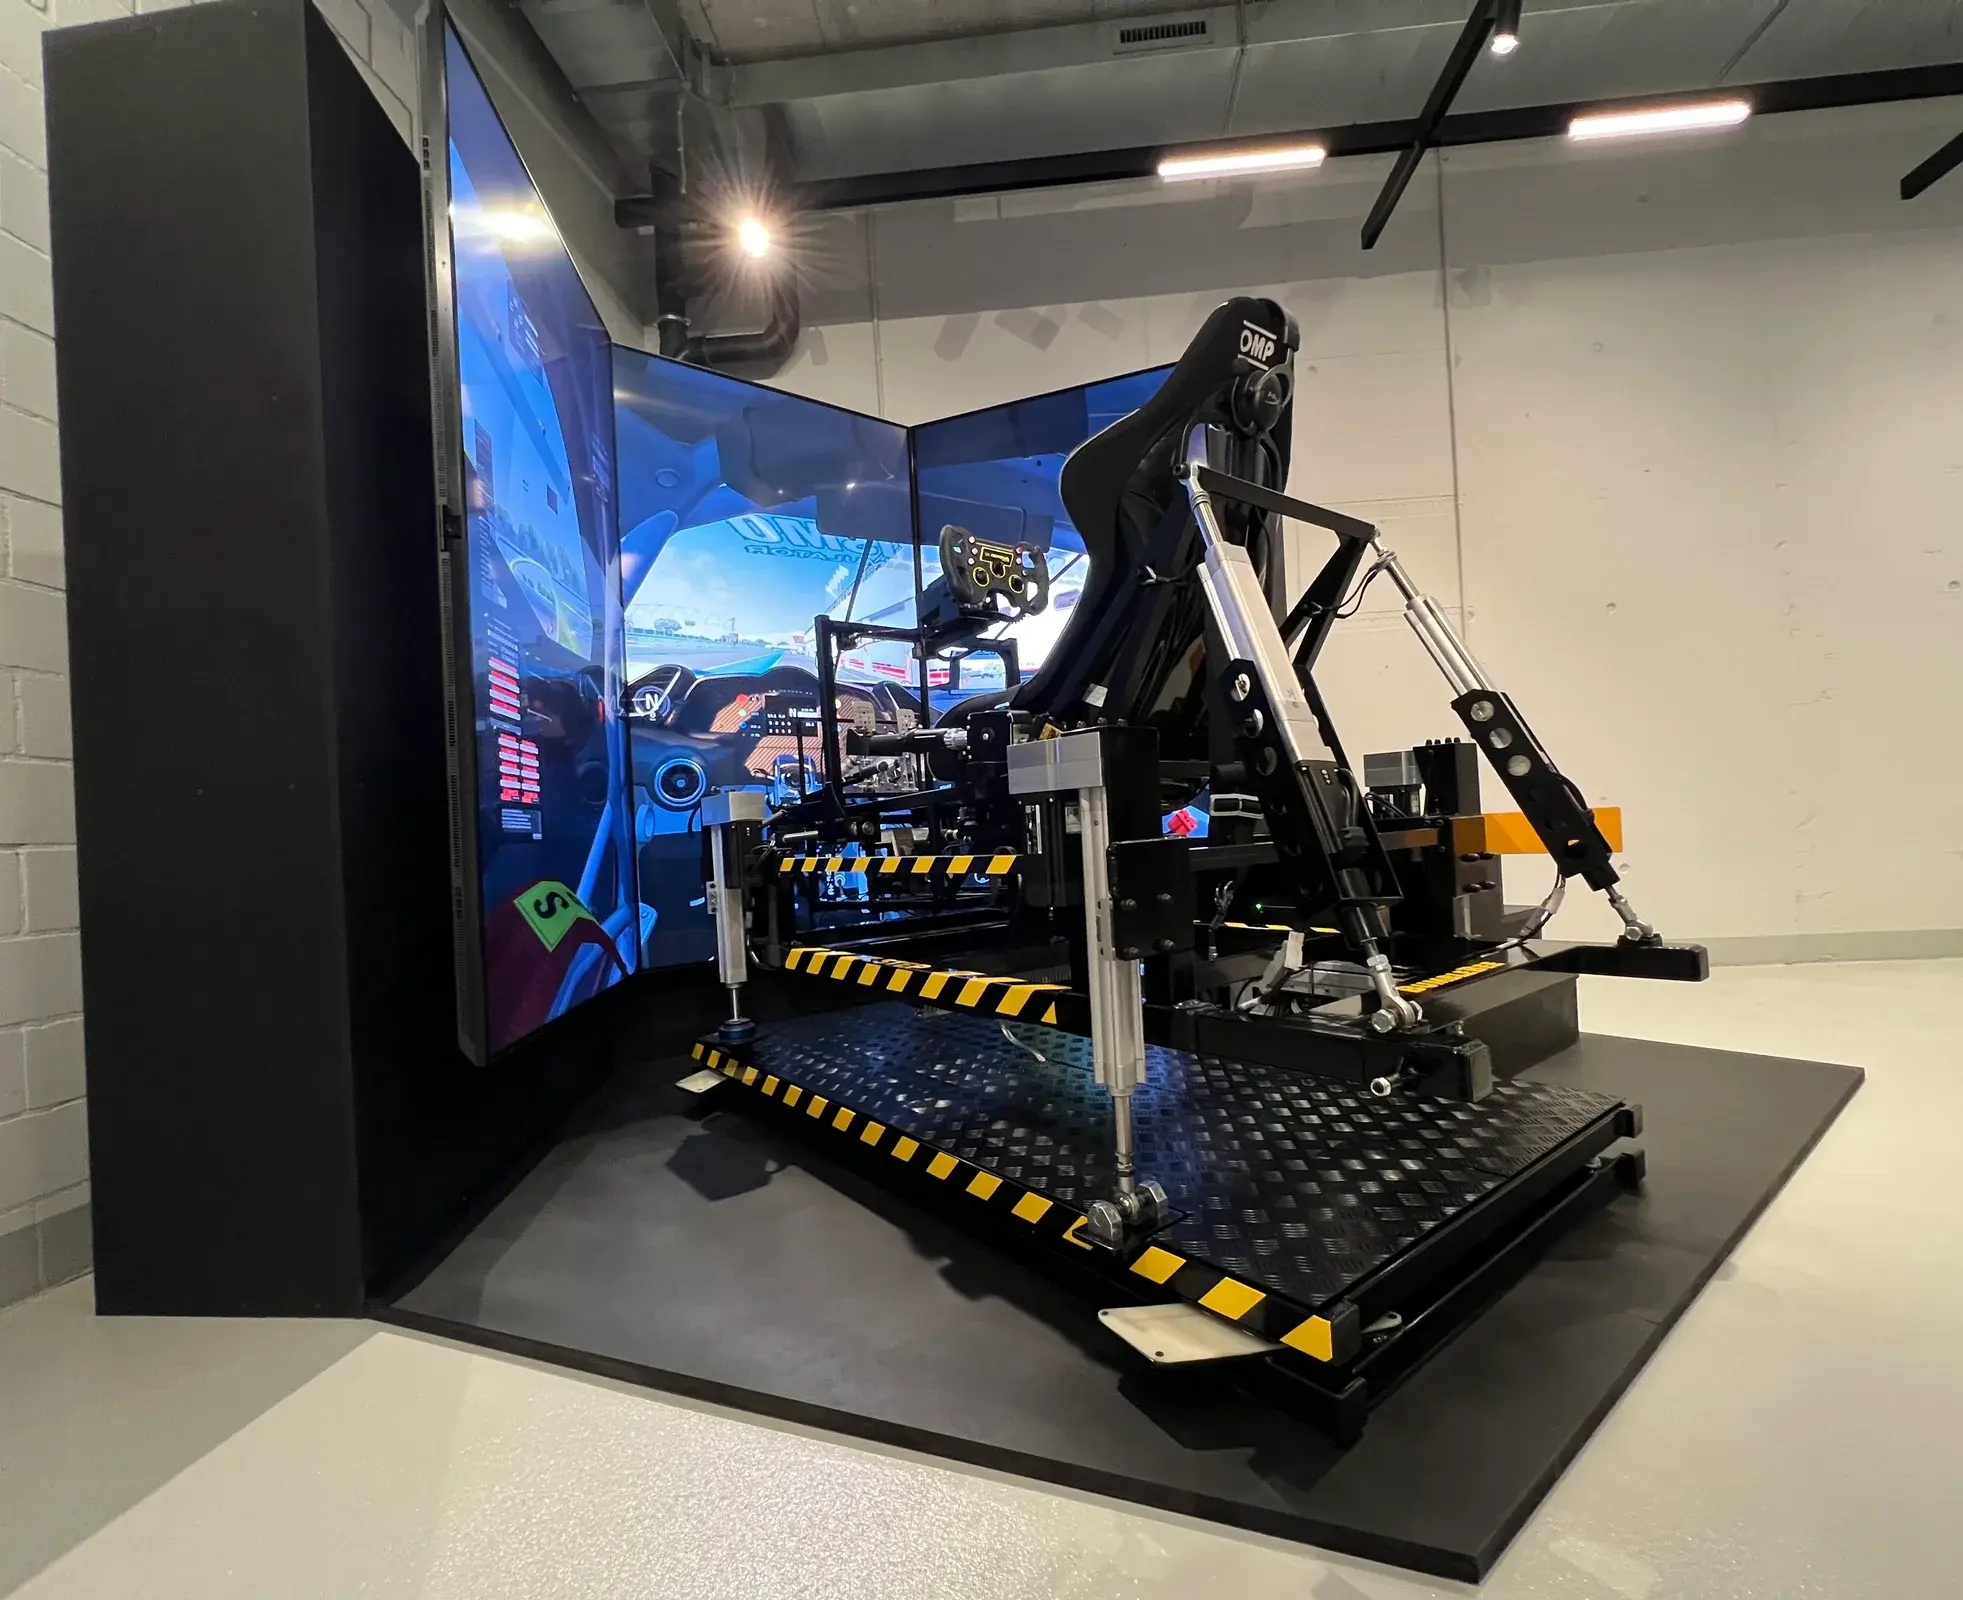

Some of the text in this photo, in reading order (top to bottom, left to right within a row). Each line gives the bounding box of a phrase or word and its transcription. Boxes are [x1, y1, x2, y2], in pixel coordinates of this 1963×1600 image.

[1240, 329, 1275, 361] OMP
[645, 693, 660, 710] N
[533, 891, 570, 919] S
